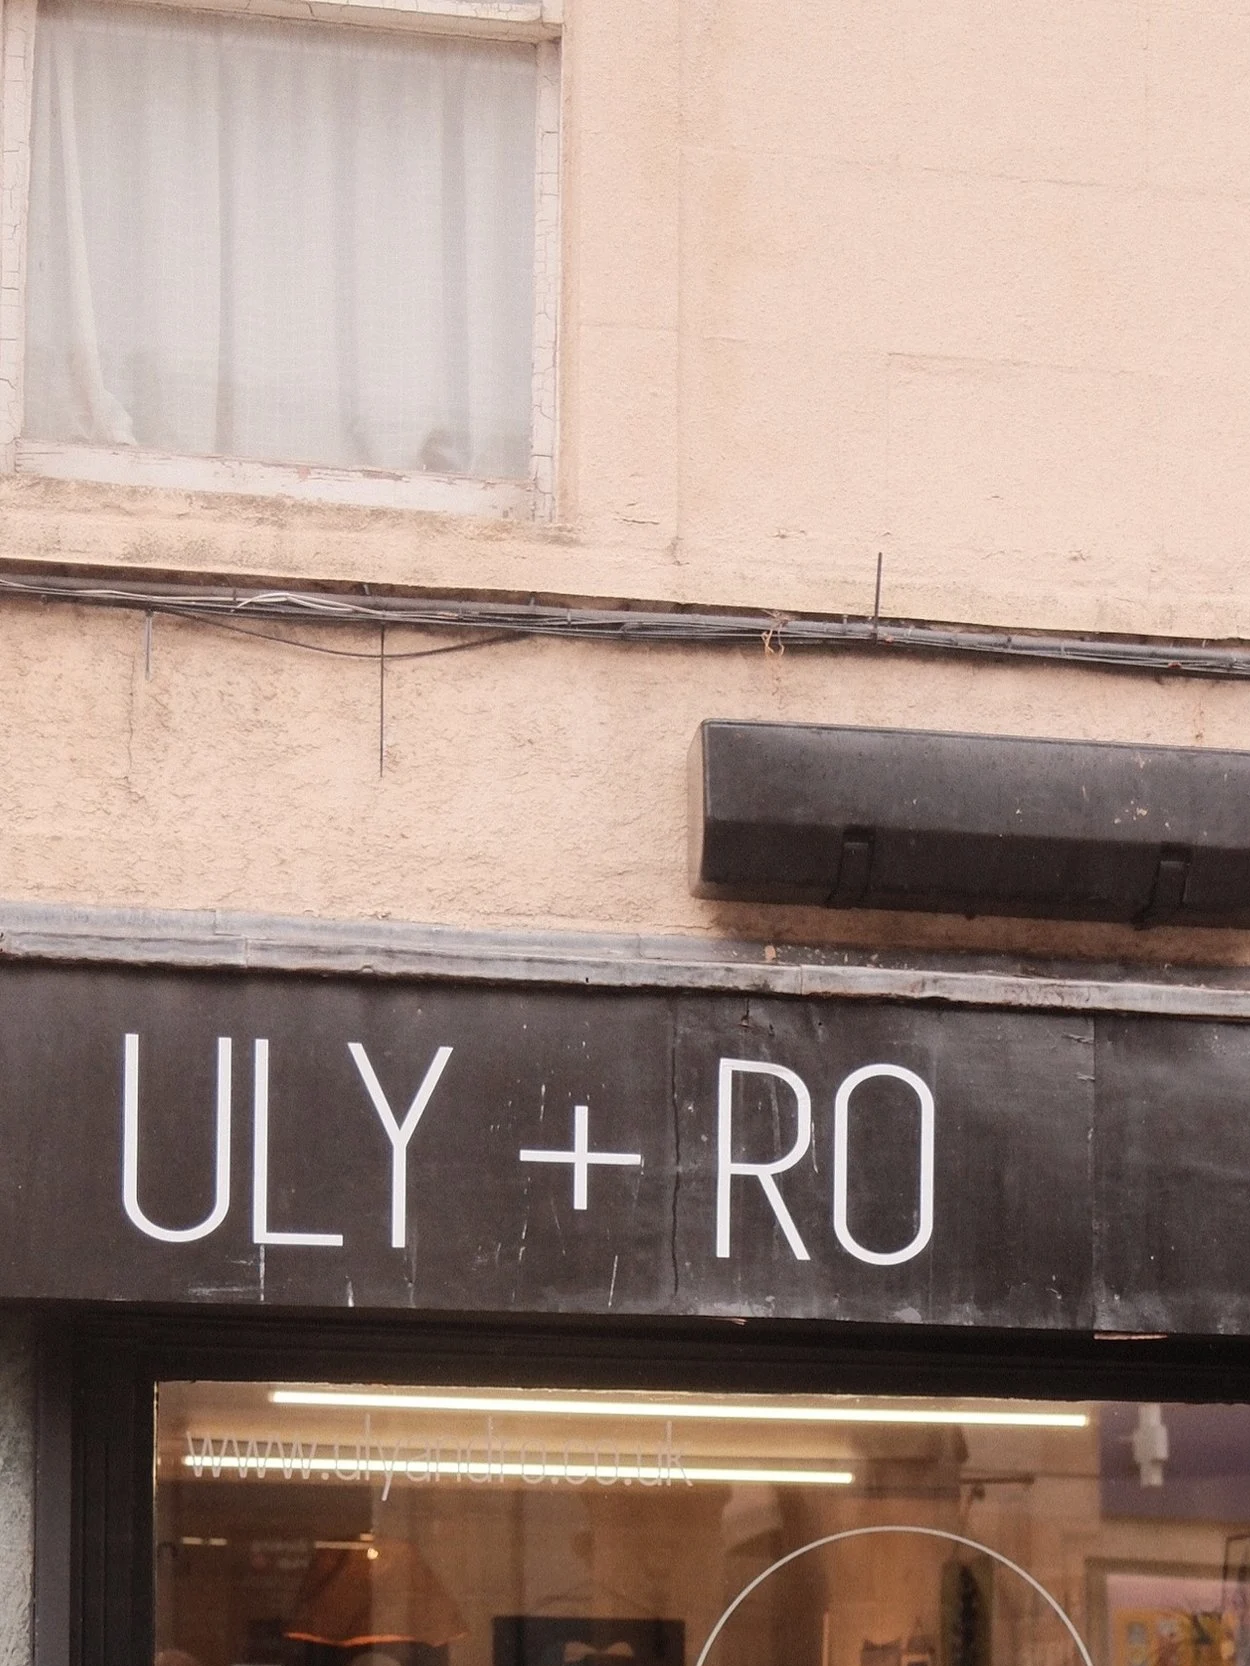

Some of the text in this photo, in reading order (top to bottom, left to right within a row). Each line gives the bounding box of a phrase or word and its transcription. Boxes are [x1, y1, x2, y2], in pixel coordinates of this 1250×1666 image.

[122, 1032, 936, 1267] ULY + RO
[186, 1413, 694, 1502] www.ulyandro.co.uk
